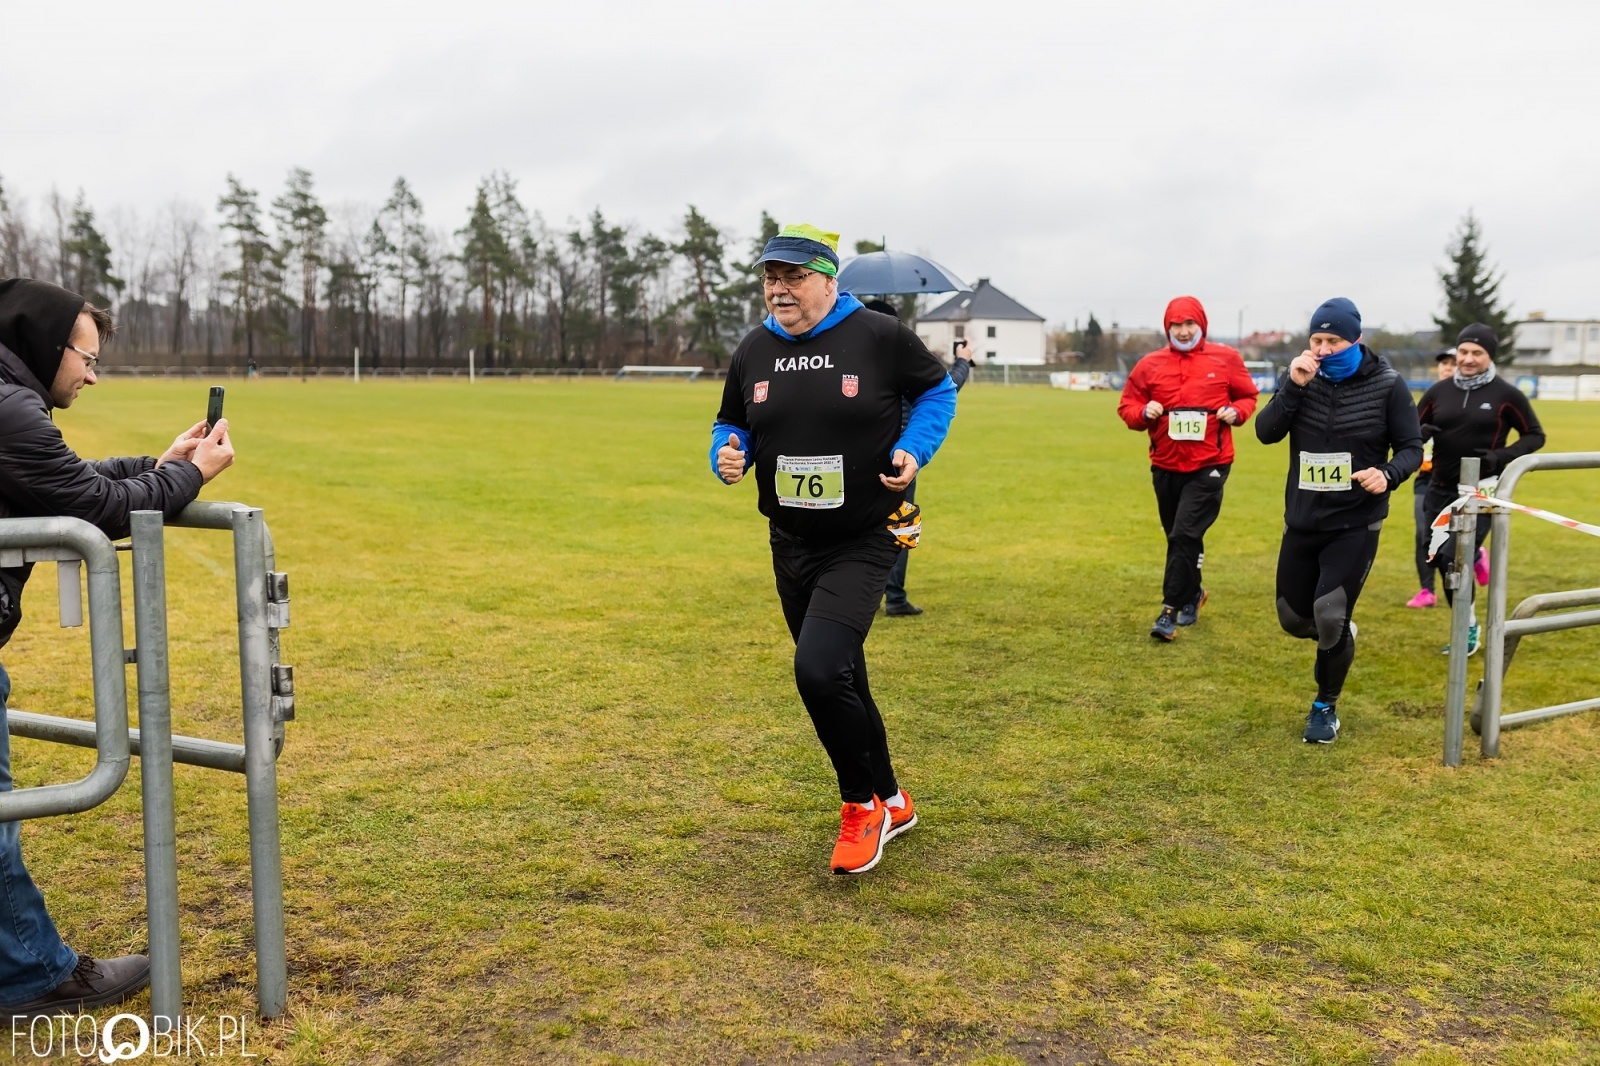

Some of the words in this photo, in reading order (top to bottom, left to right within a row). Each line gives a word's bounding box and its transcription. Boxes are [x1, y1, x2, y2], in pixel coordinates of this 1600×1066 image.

[774, 354, 835, 372] KAROL
[1176, 421, 1201, 434] 115
[1307, 466, 1342, 483] 114
[791, 474, 824, 498] 76
